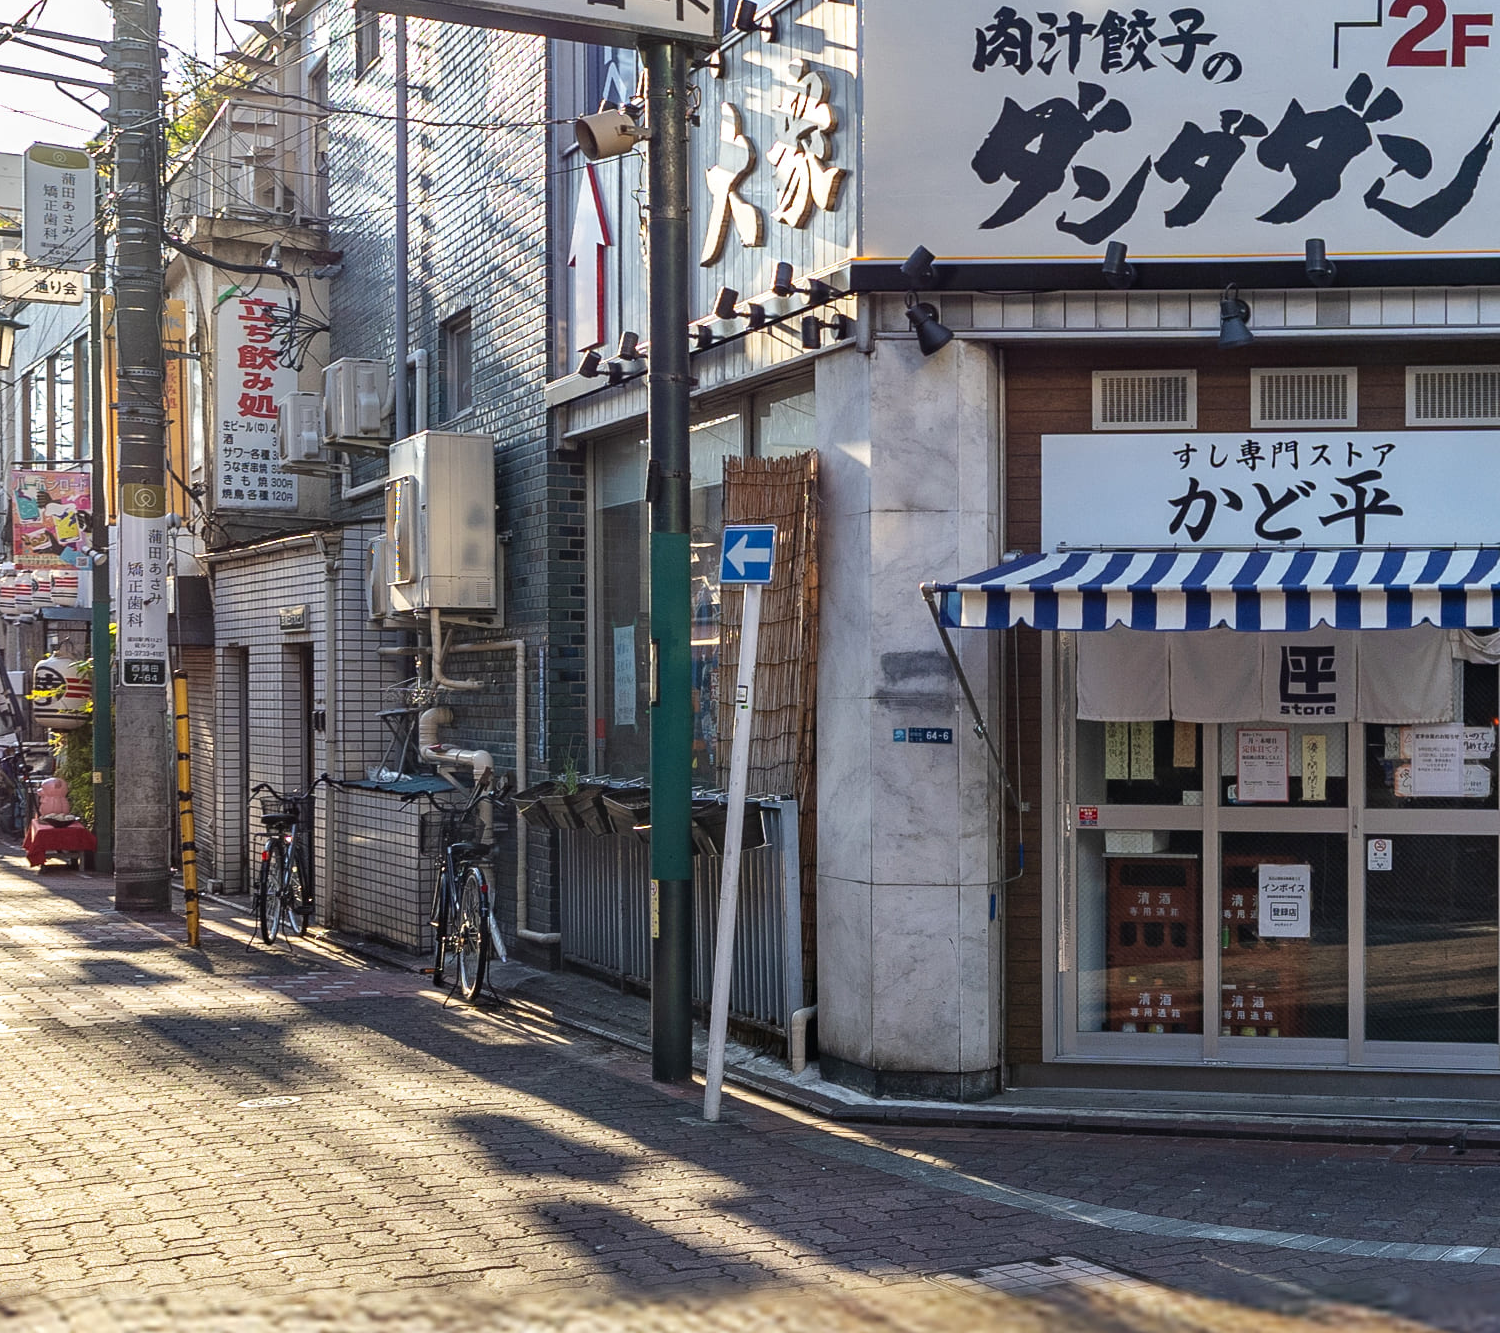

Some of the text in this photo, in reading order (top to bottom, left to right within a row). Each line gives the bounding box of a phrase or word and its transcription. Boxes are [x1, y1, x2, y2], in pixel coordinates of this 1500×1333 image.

[971, 6, 1243, 83] 肉汁餃子の
[237, 298, 279, 420] 立ち飲み処
[223, 421, 270, 433] 生ビール(中)
[223, 434, 234, 445] 酒
[223, 447, 270, 460] サワー各種
[1173, 440, 1397, 471] すし専門ストア
[271, 477, 293, 489] 300円
[272, 490, 293, 502] 120円
[1168, 470, 1404, 545] かど平
[148, 529, 163, 606] 蒲田あさみ
[127, 561, 144, 629] 矯正歯科
[132, 674, 158, 682] 7-64
[1280, 703, 1337, 716] store
[926, 731, 949, 741] 64-6
[1261, 883, 1306, 893] インボイス
[1272, 906, 1298, 917] 登録店
